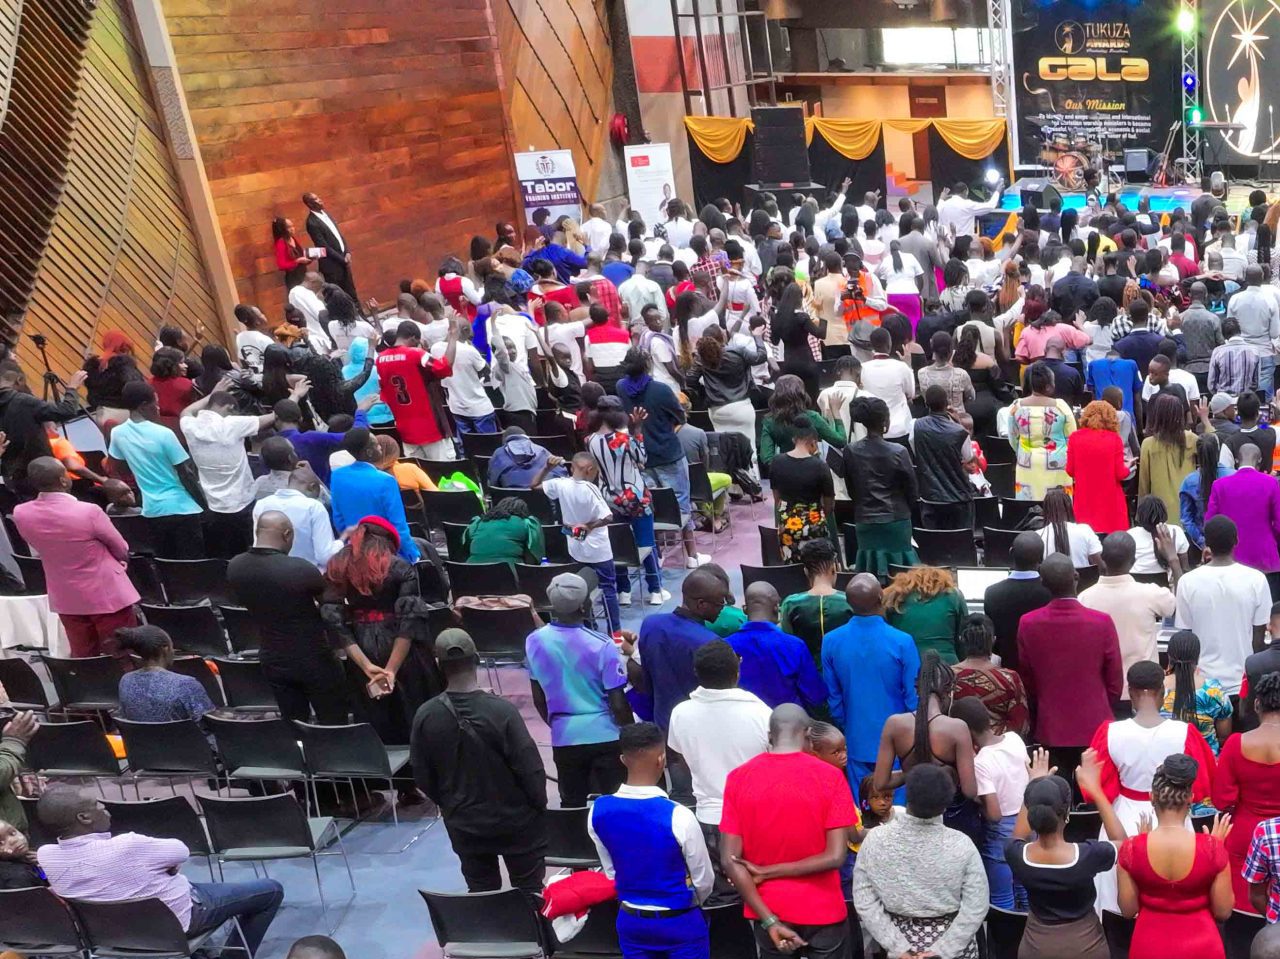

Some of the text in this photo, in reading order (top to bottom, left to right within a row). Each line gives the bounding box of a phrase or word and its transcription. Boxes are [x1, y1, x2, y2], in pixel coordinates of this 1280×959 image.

[1084, 22, 1131, 39] TUKUZA
[1065, 99, 1126, 111] Our Mission
[522, 180, 575, 194] Tabor
[391, 375, 412, 405] 3
